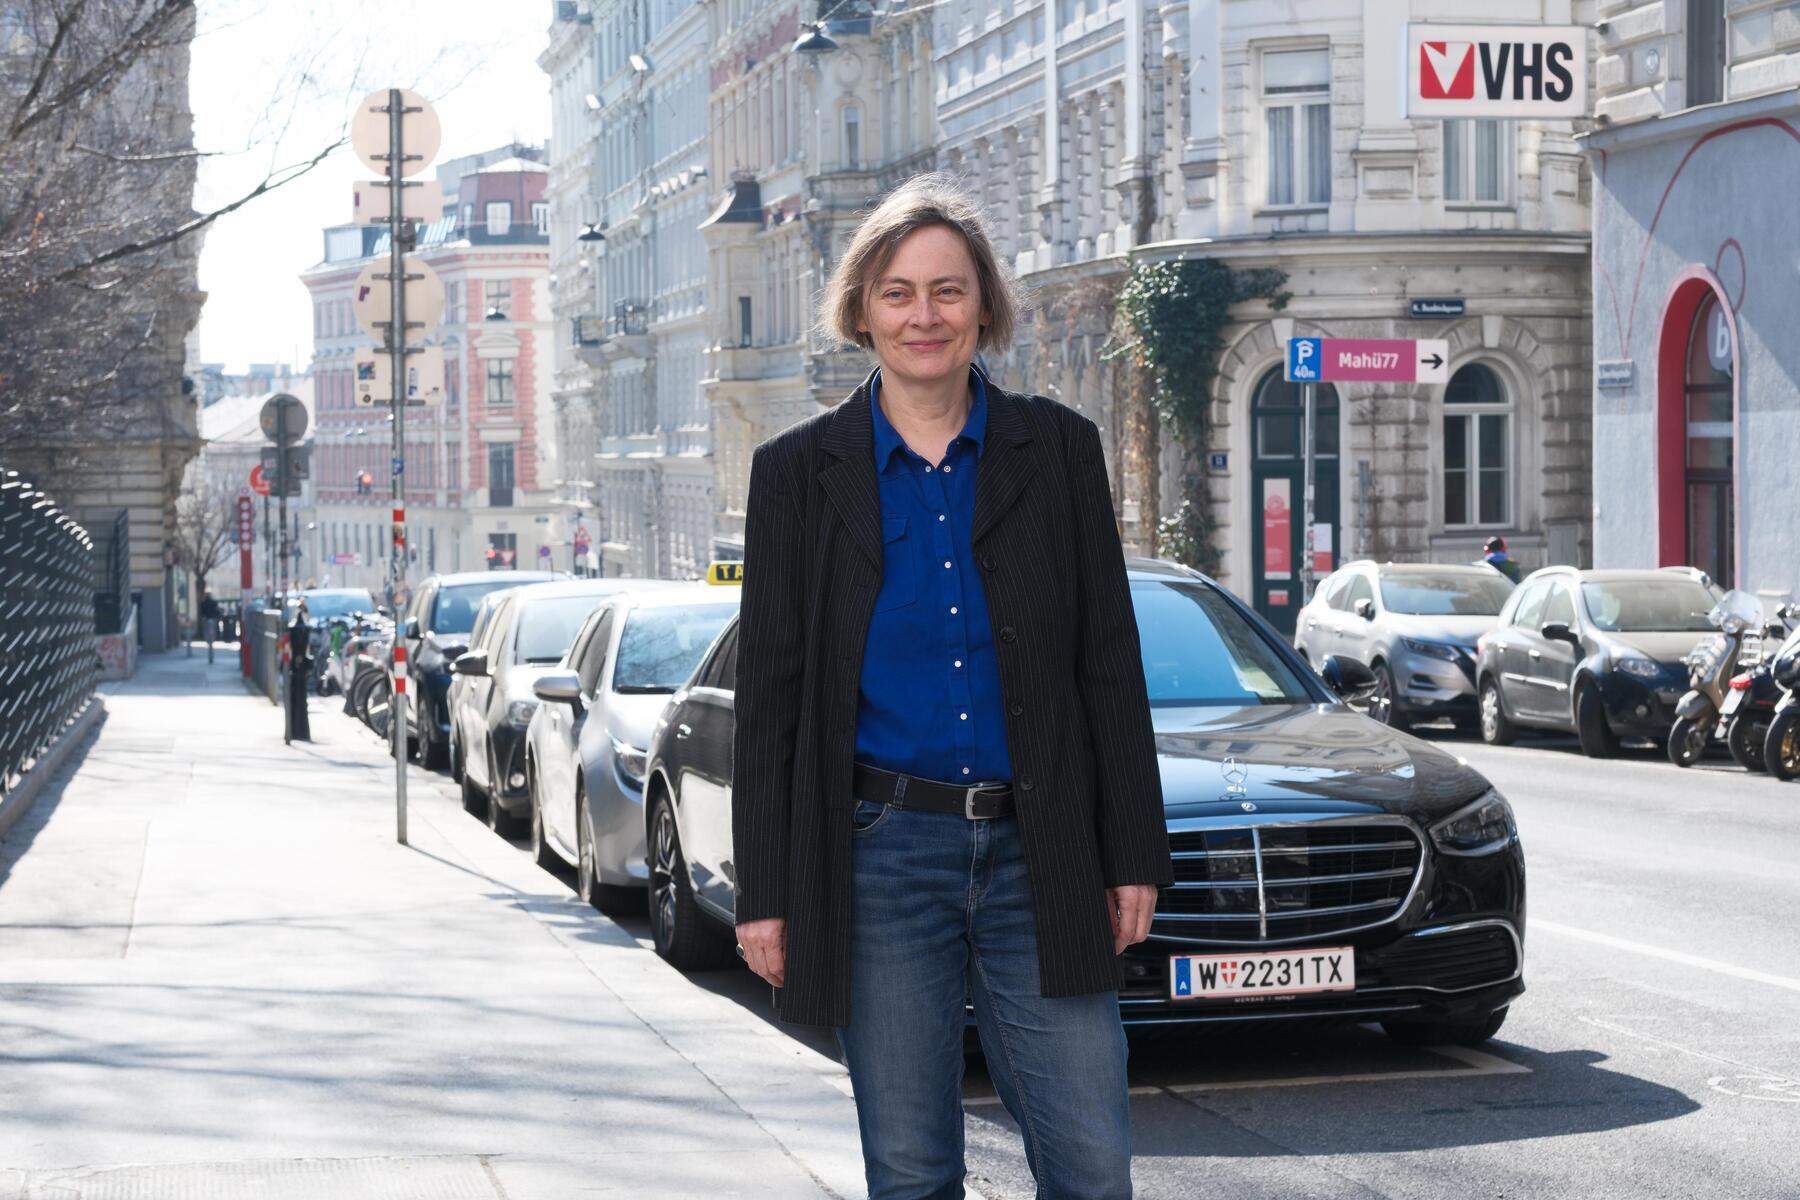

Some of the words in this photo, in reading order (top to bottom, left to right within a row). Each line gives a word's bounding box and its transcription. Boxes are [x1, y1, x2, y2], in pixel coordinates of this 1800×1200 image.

[1478, 42, 1573, 102] VHS
[1338, 352, 1399, 369] Mahü77
[1294, 365, 1315, 378] 40m
[1198, 962, 1218, 990] W
[1179, 981, 1187, 990] A
